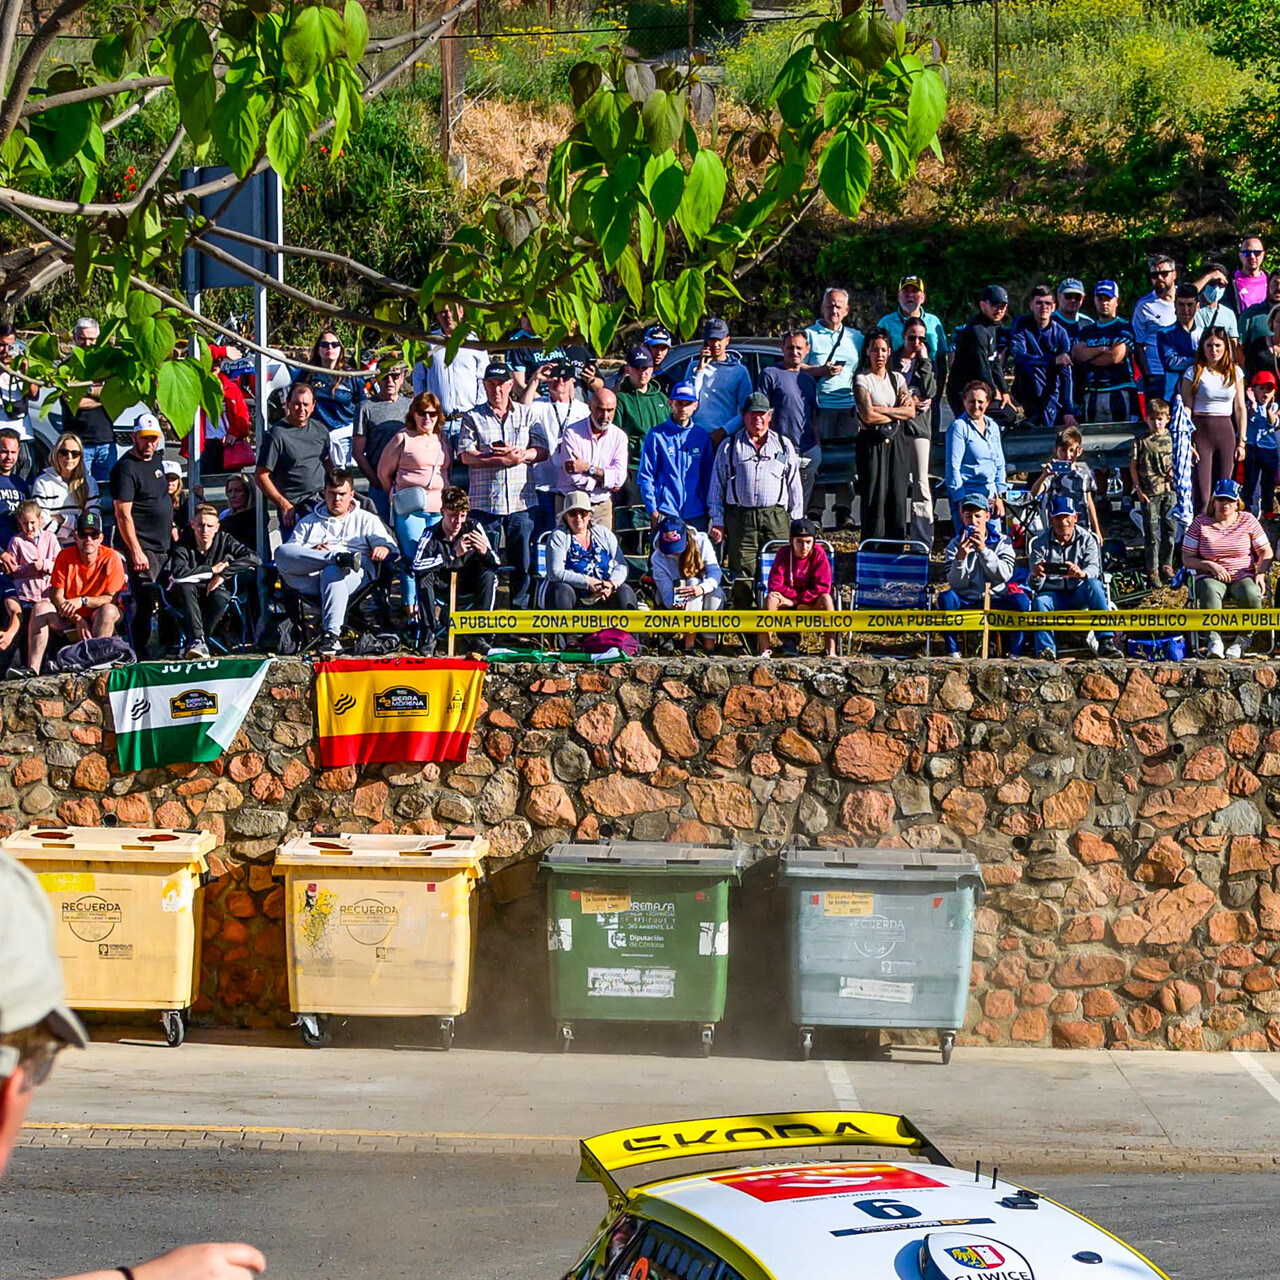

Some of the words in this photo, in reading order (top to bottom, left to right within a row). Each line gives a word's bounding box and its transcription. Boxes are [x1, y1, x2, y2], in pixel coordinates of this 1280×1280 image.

[459, 615, 517, 629] PUBLICO
[532, 615, 568, 629] ZONA
[570, 615, 629, 629] PUBLICO
[644, 615, 680, 629] ZONA
[683, 615, 741, 629] PUBLICO
[755, 614, 792, 628] ZONA
[794, 615, 853, 629] PUBLICO
[867, 614, 904, 628] ZONA
[906, 613, 964, 627] PUBLICO
[1017, 615, 1075, 627] PUBLICO
[1089, 614, 1128, 627] ZONA
[1130, 613, 1187, 627] PUBLICO
[1202, 613, 1240, 627] ZONA
[378, 696, 391, 707] 42
[61, 902, 121, 912] RECUERDA
[339, 905, 399, 915] RECUERDA
